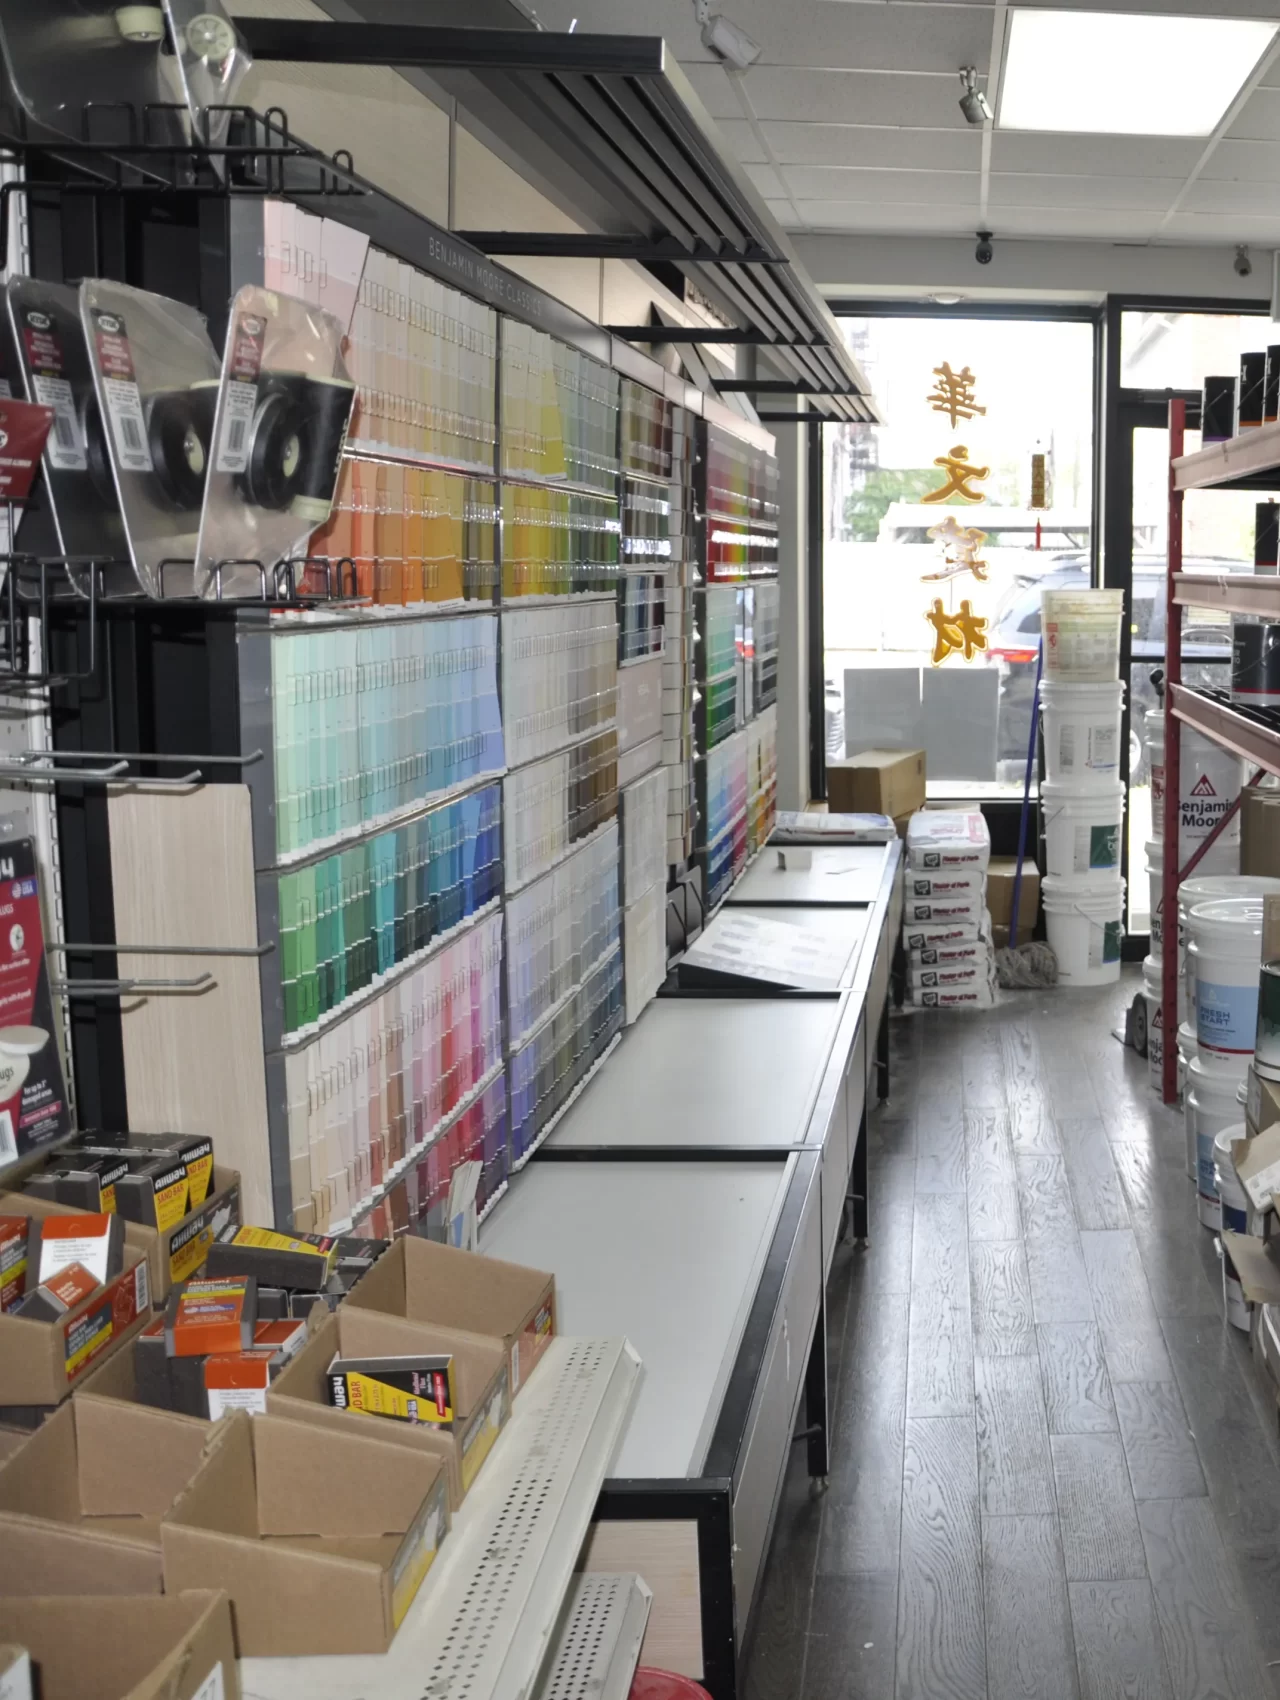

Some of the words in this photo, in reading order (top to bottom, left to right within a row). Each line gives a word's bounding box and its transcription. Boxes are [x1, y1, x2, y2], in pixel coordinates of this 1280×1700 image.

[428, 236, 474, 279] BENJAMIN
[476, 265, 504, 297] MOORE
[101, 1162, 129, 1186] Allway
[155, 1166, 186, 1190] Allway
[157, 1190, 173, 1204] SAND
[172, 1183, 185, 1196] BAR
[171, 1214, 204, 1252] Allway
